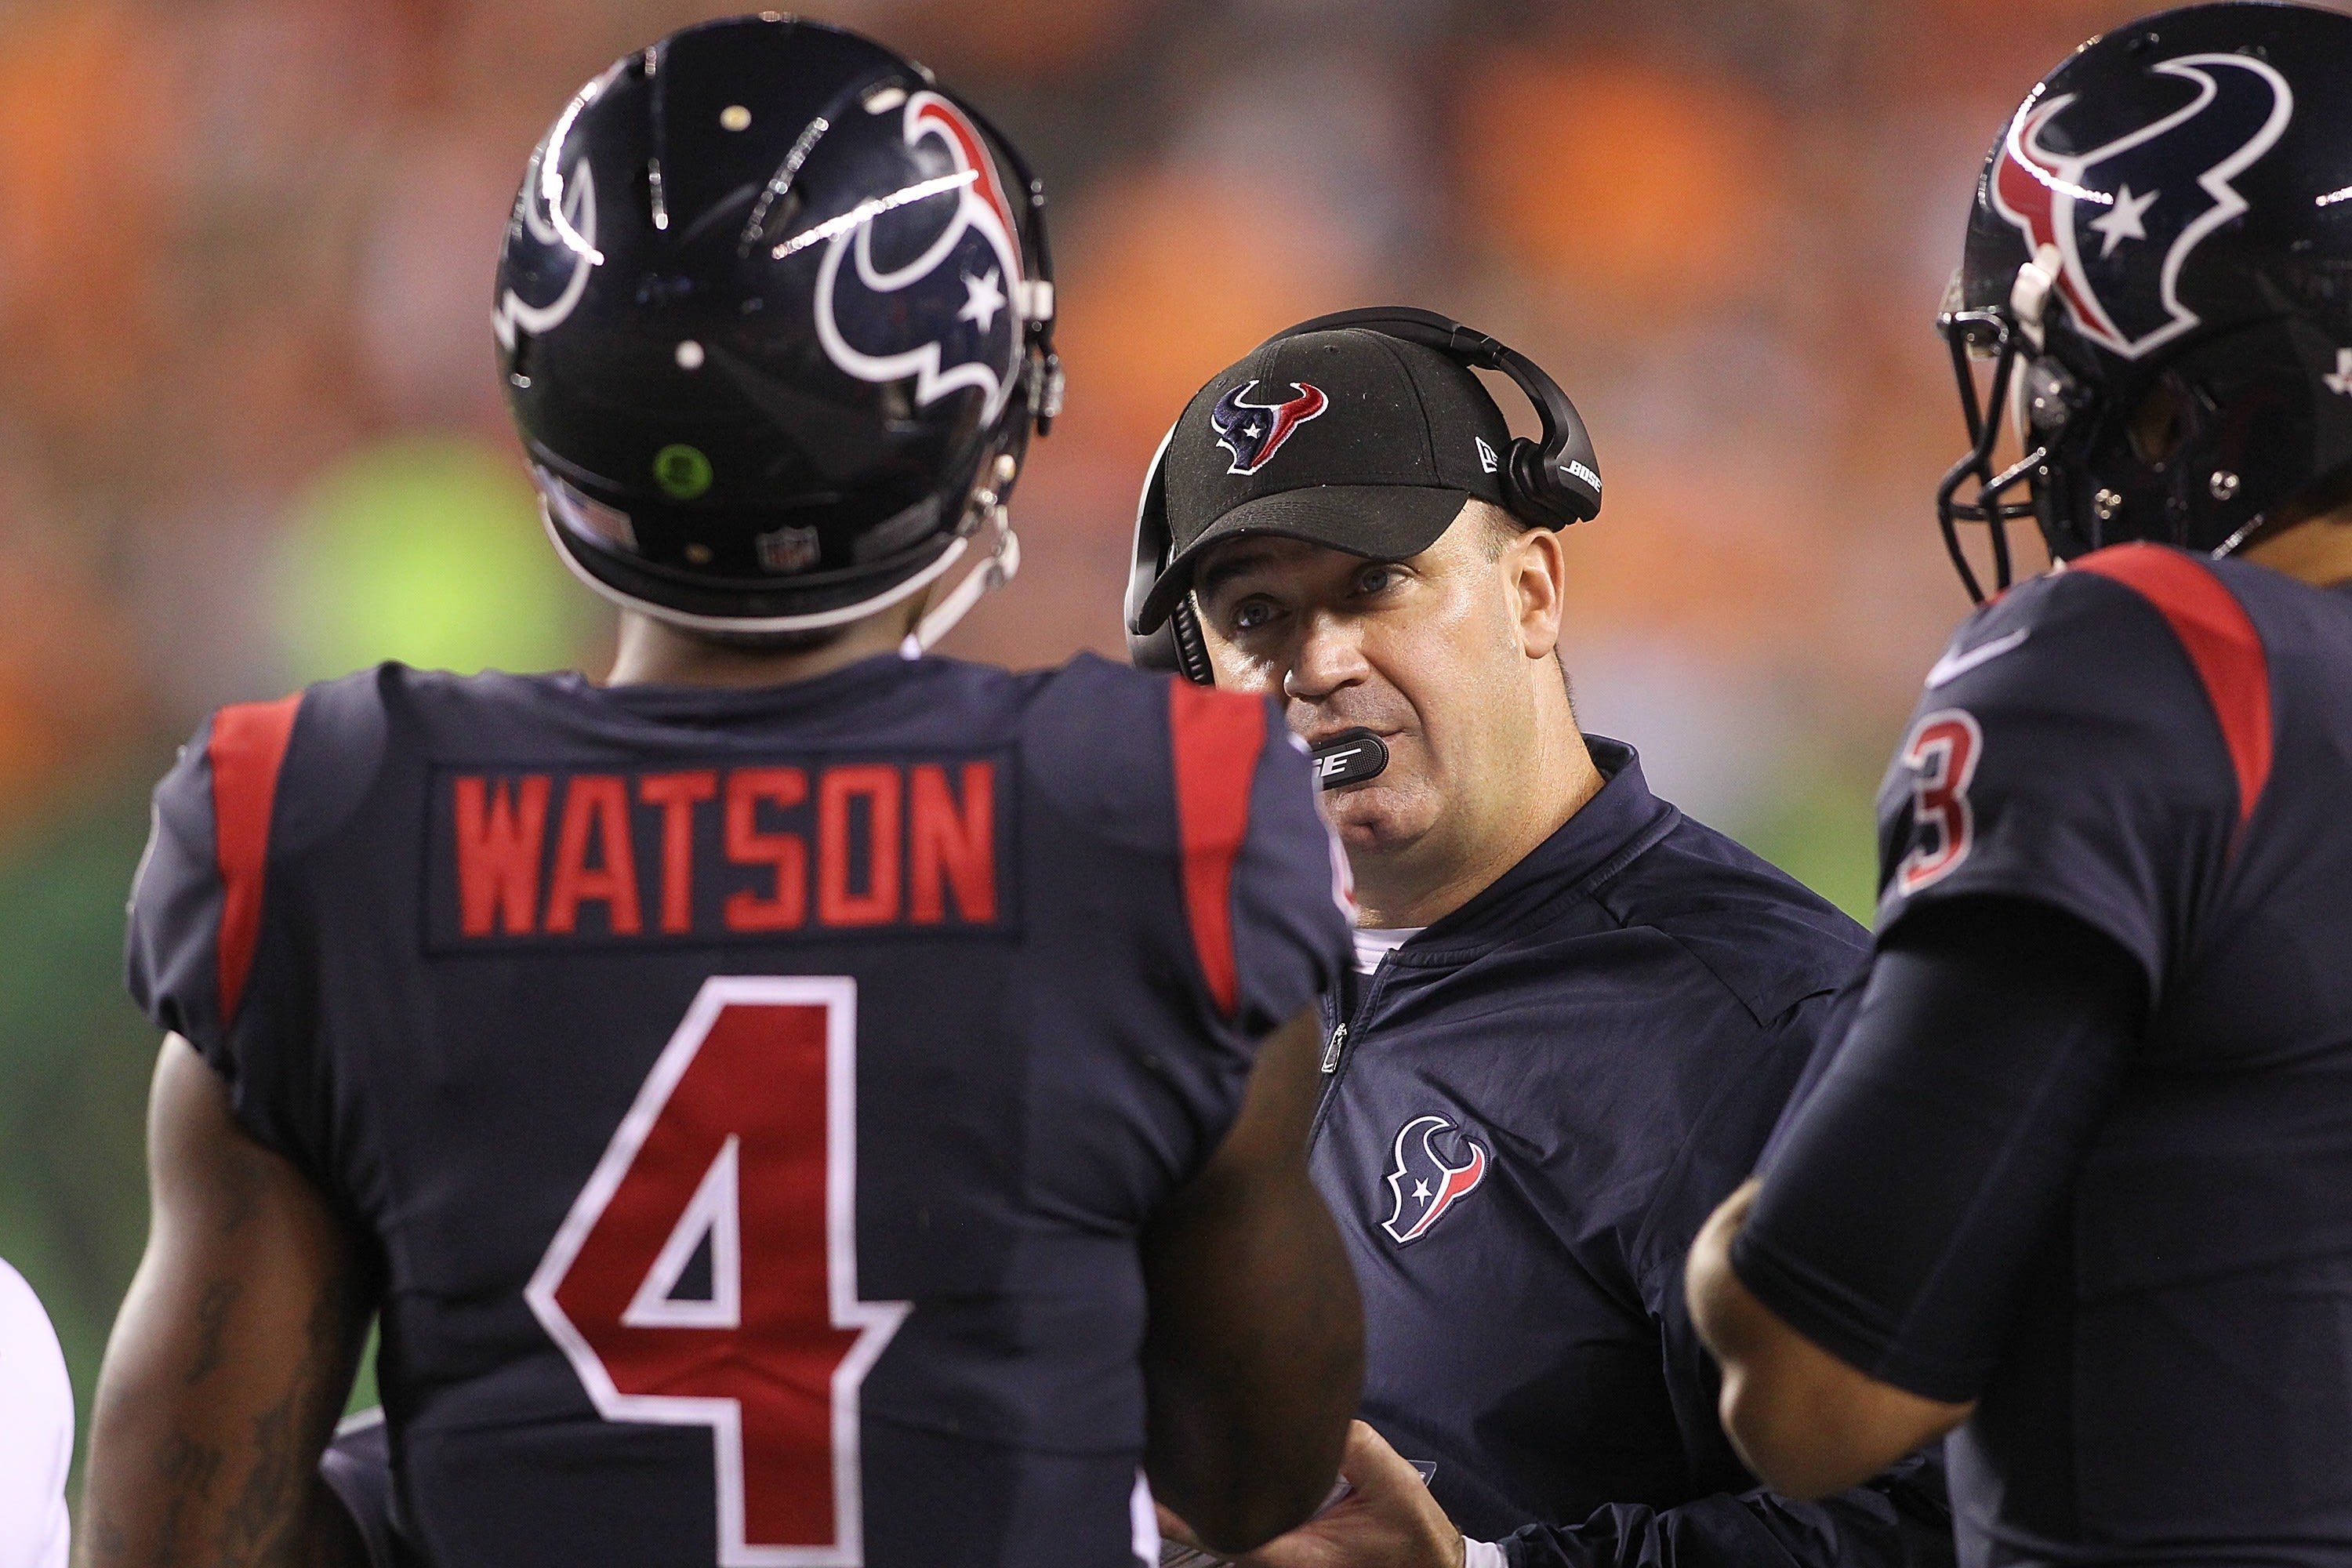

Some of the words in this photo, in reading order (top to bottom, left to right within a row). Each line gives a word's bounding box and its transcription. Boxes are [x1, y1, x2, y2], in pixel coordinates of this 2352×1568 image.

[1560, 459, 1602, 493] BOSE
[453, 760, 996, 935] WATSON
[1897, 707, 1984, 898] 3
[523, 975, 914, 1567] 4
